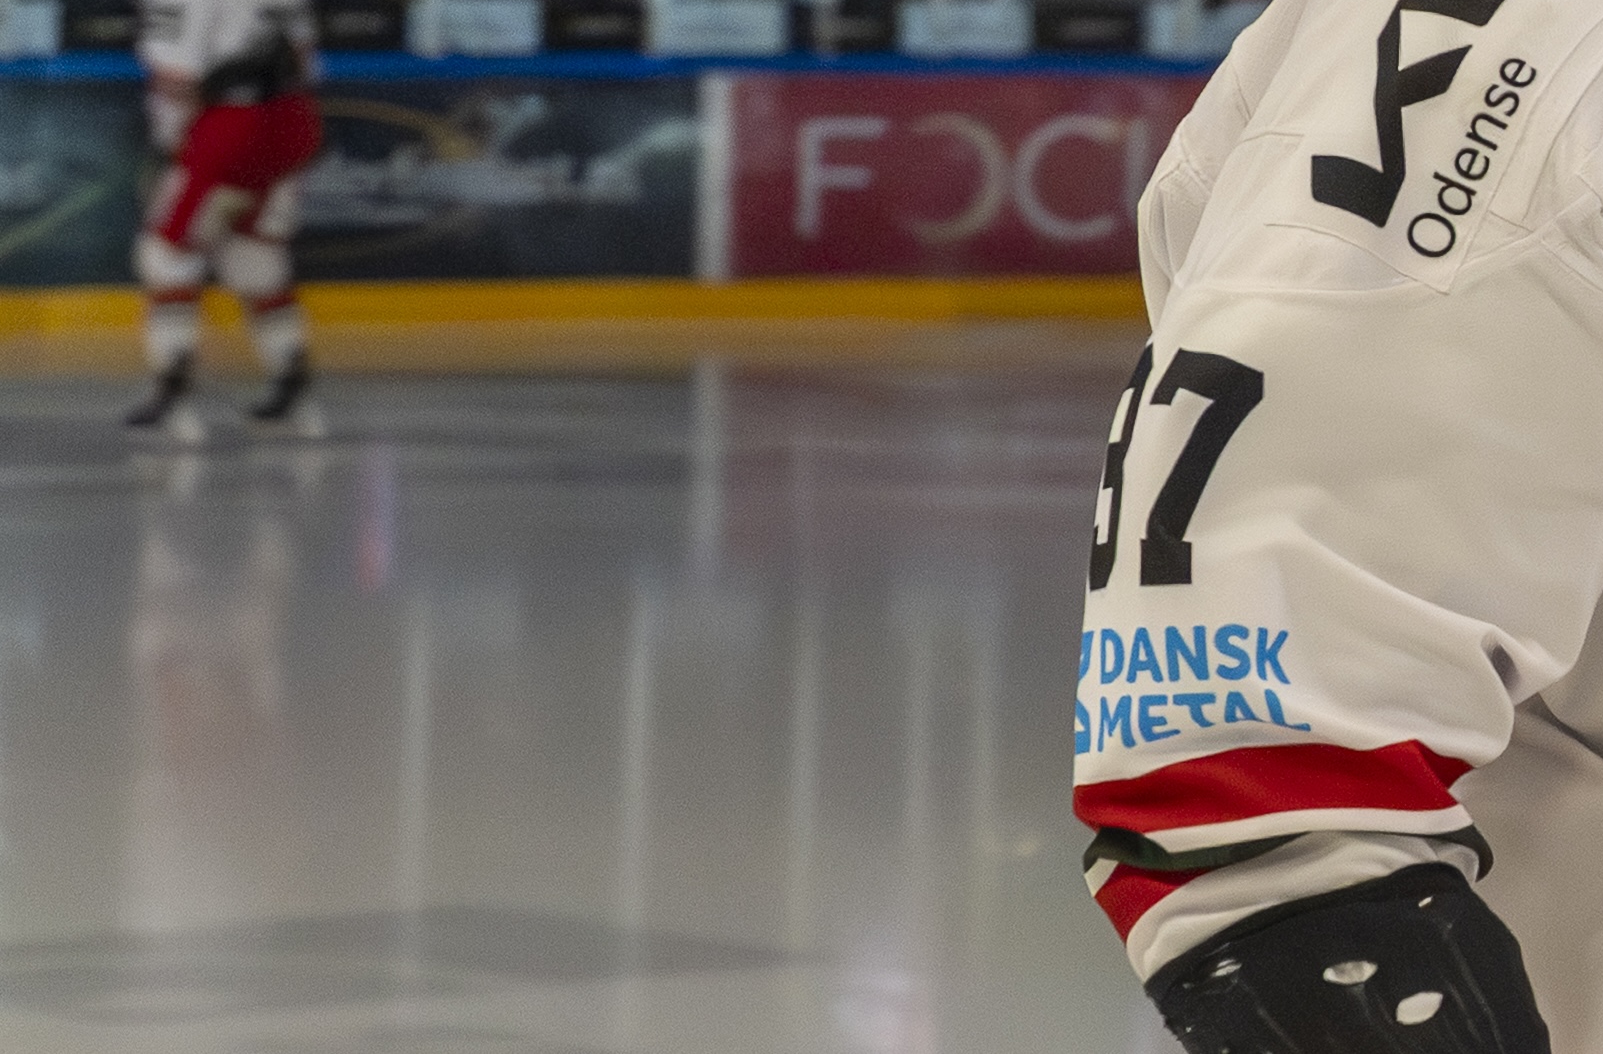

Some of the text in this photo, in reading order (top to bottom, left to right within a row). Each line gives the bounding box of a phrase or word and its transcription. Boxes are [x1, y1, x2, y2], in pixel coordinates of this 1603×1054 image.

[1406, 56, 1537, 259] Odense
[1099, 623, 1292, 687] DANSK
[1097, 688, 1312, 754] METAL
